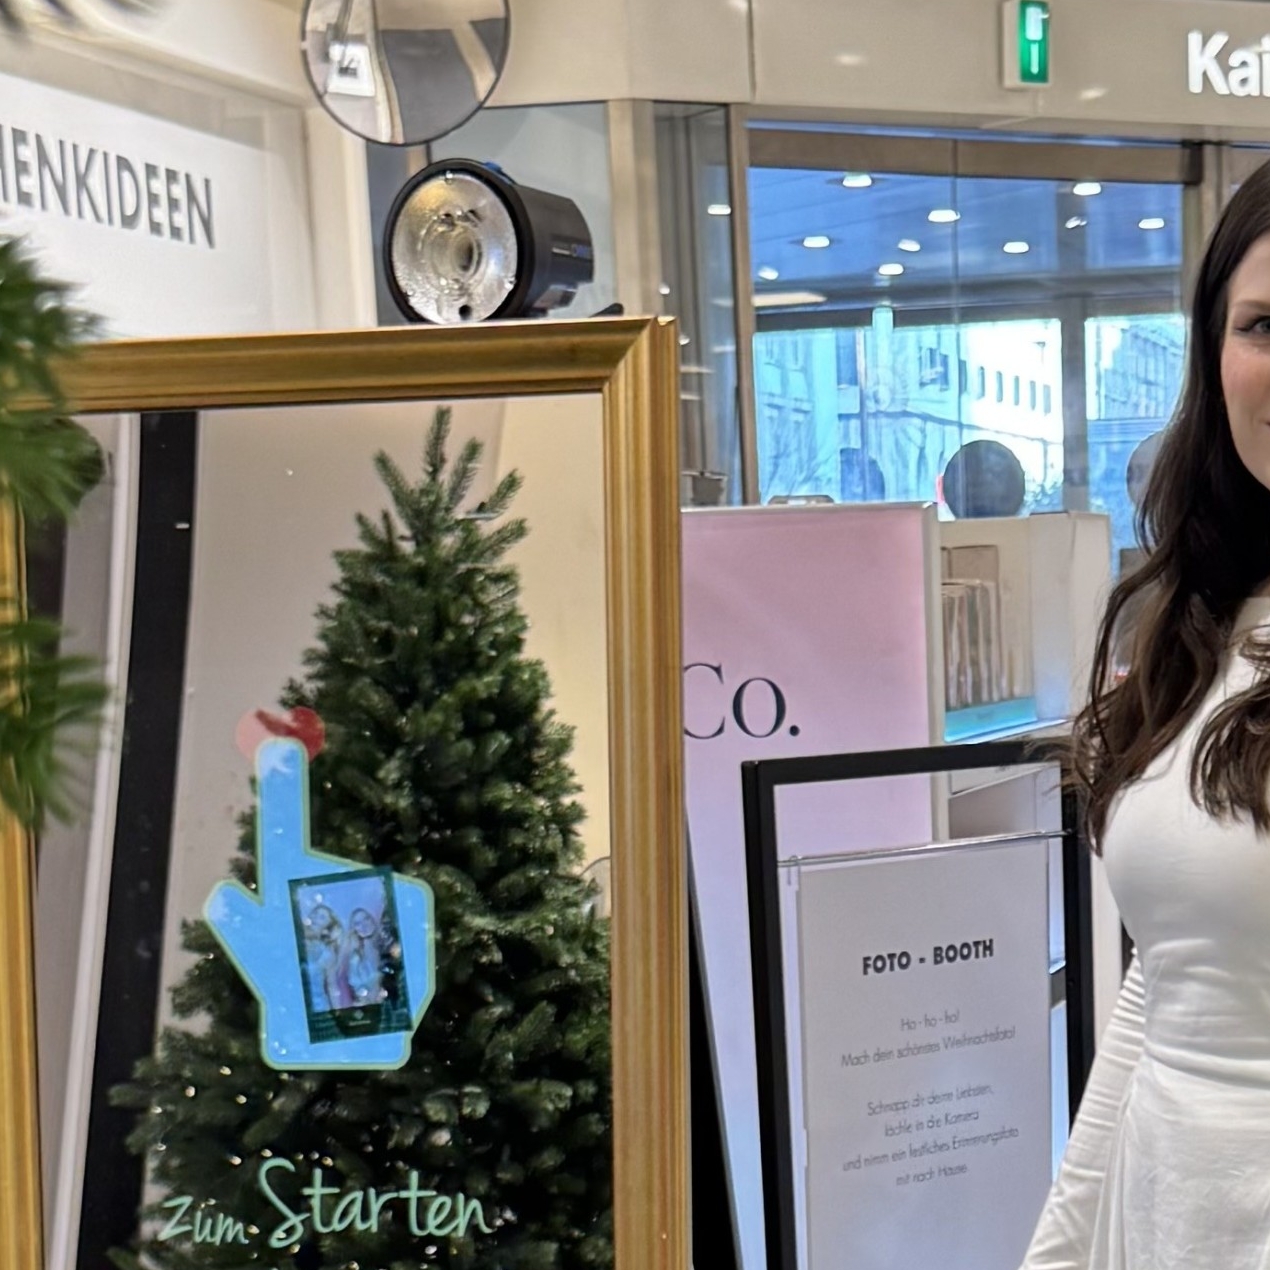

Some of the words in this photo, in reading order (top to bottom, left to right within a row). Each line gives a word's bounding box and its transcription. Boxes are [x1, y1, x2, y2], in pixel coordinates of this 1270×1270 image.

[862, 951, 911, 976] FOTO
[933, 938, 994, 965] BOOTH
[841, 1050, 870, 1067] Mach
[843, 1153, 862, 1171] und
[258, 1157, 496, 1249] Starten
